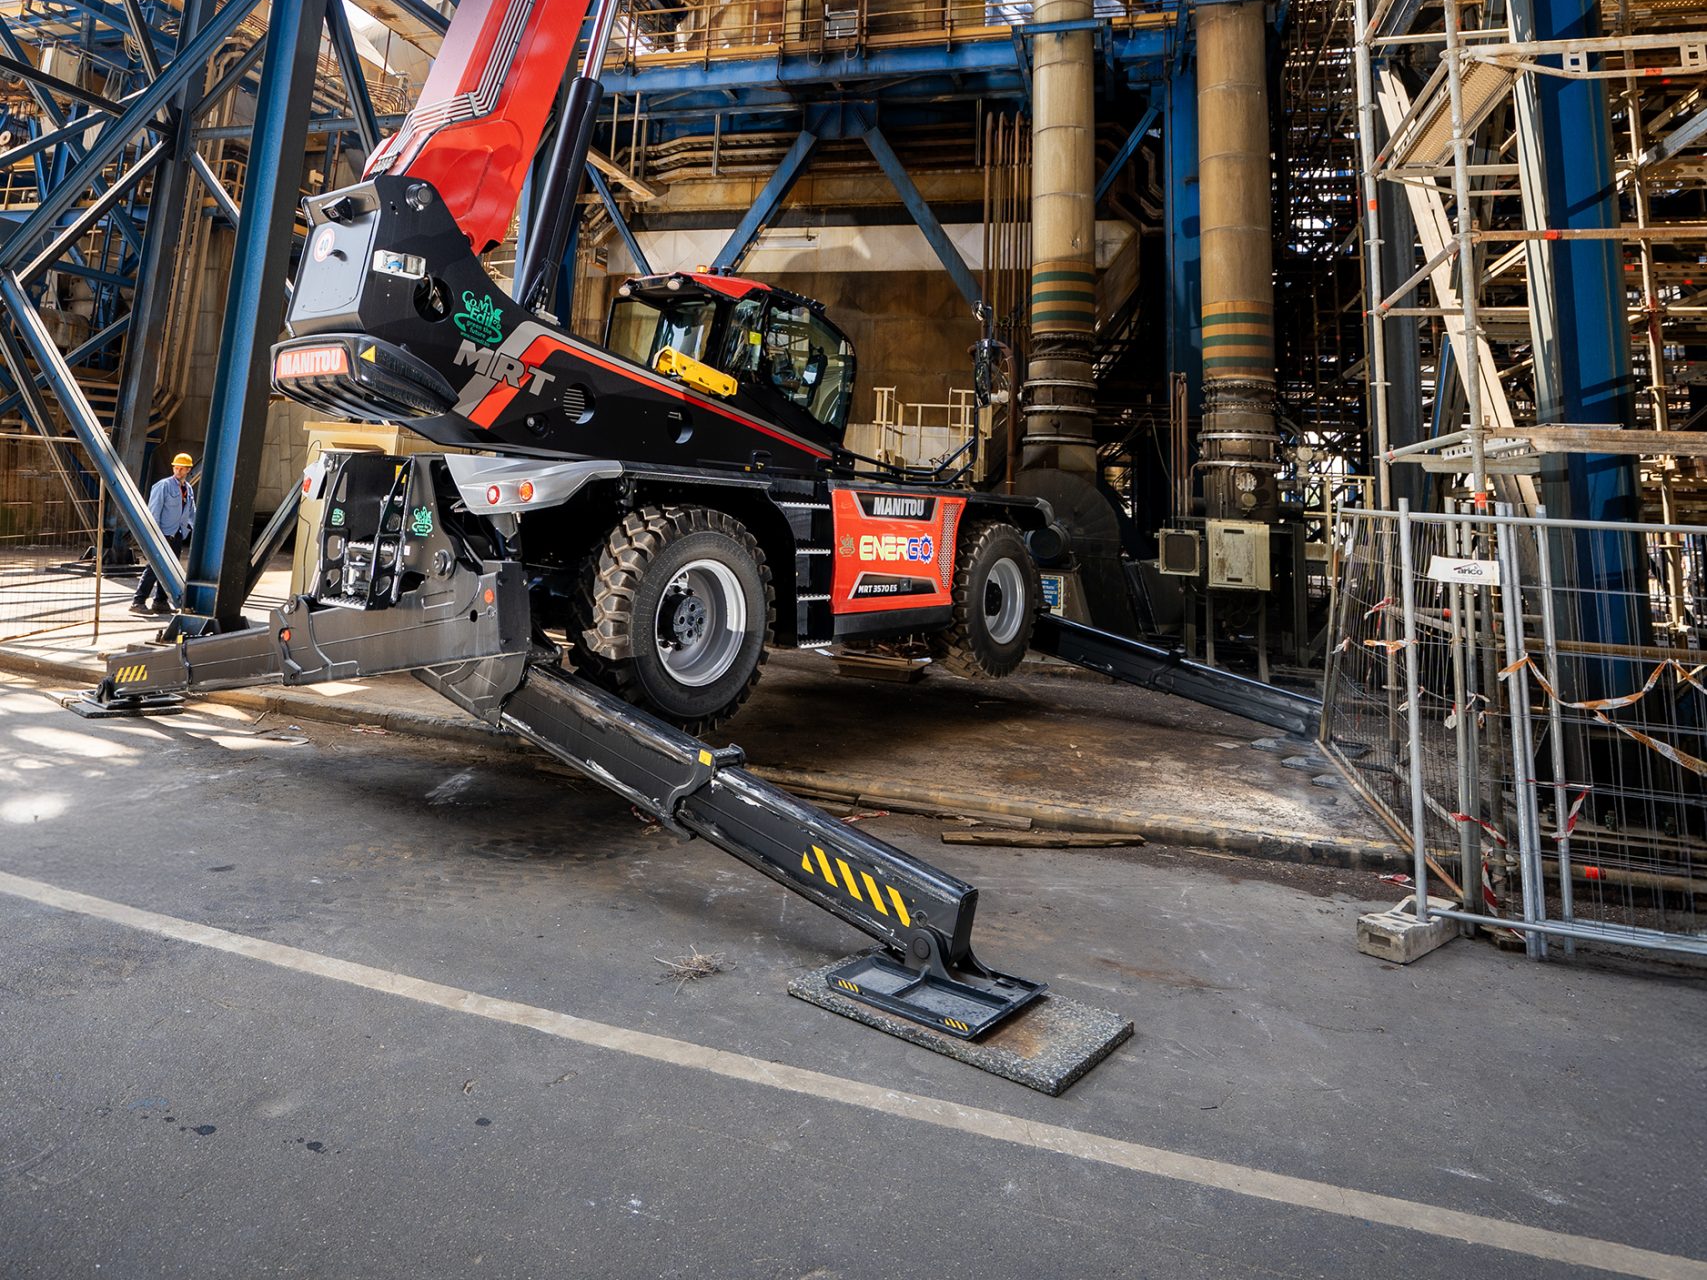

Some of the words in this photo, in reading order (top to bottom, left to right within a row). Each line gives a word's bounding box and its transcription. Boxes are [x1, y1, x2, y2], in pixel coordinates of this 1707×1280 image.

[281, 349, 341, 375] MANITOU
[453, 339, 556, 396] MRT
[873, 497, 924, 516] MANITOU
[860, 533, 934, 564] ENERGO
[858, 585, 873, 593] MRT
[873, 585, 890, 593] 3570
[889, 584, 897, 592] ES
